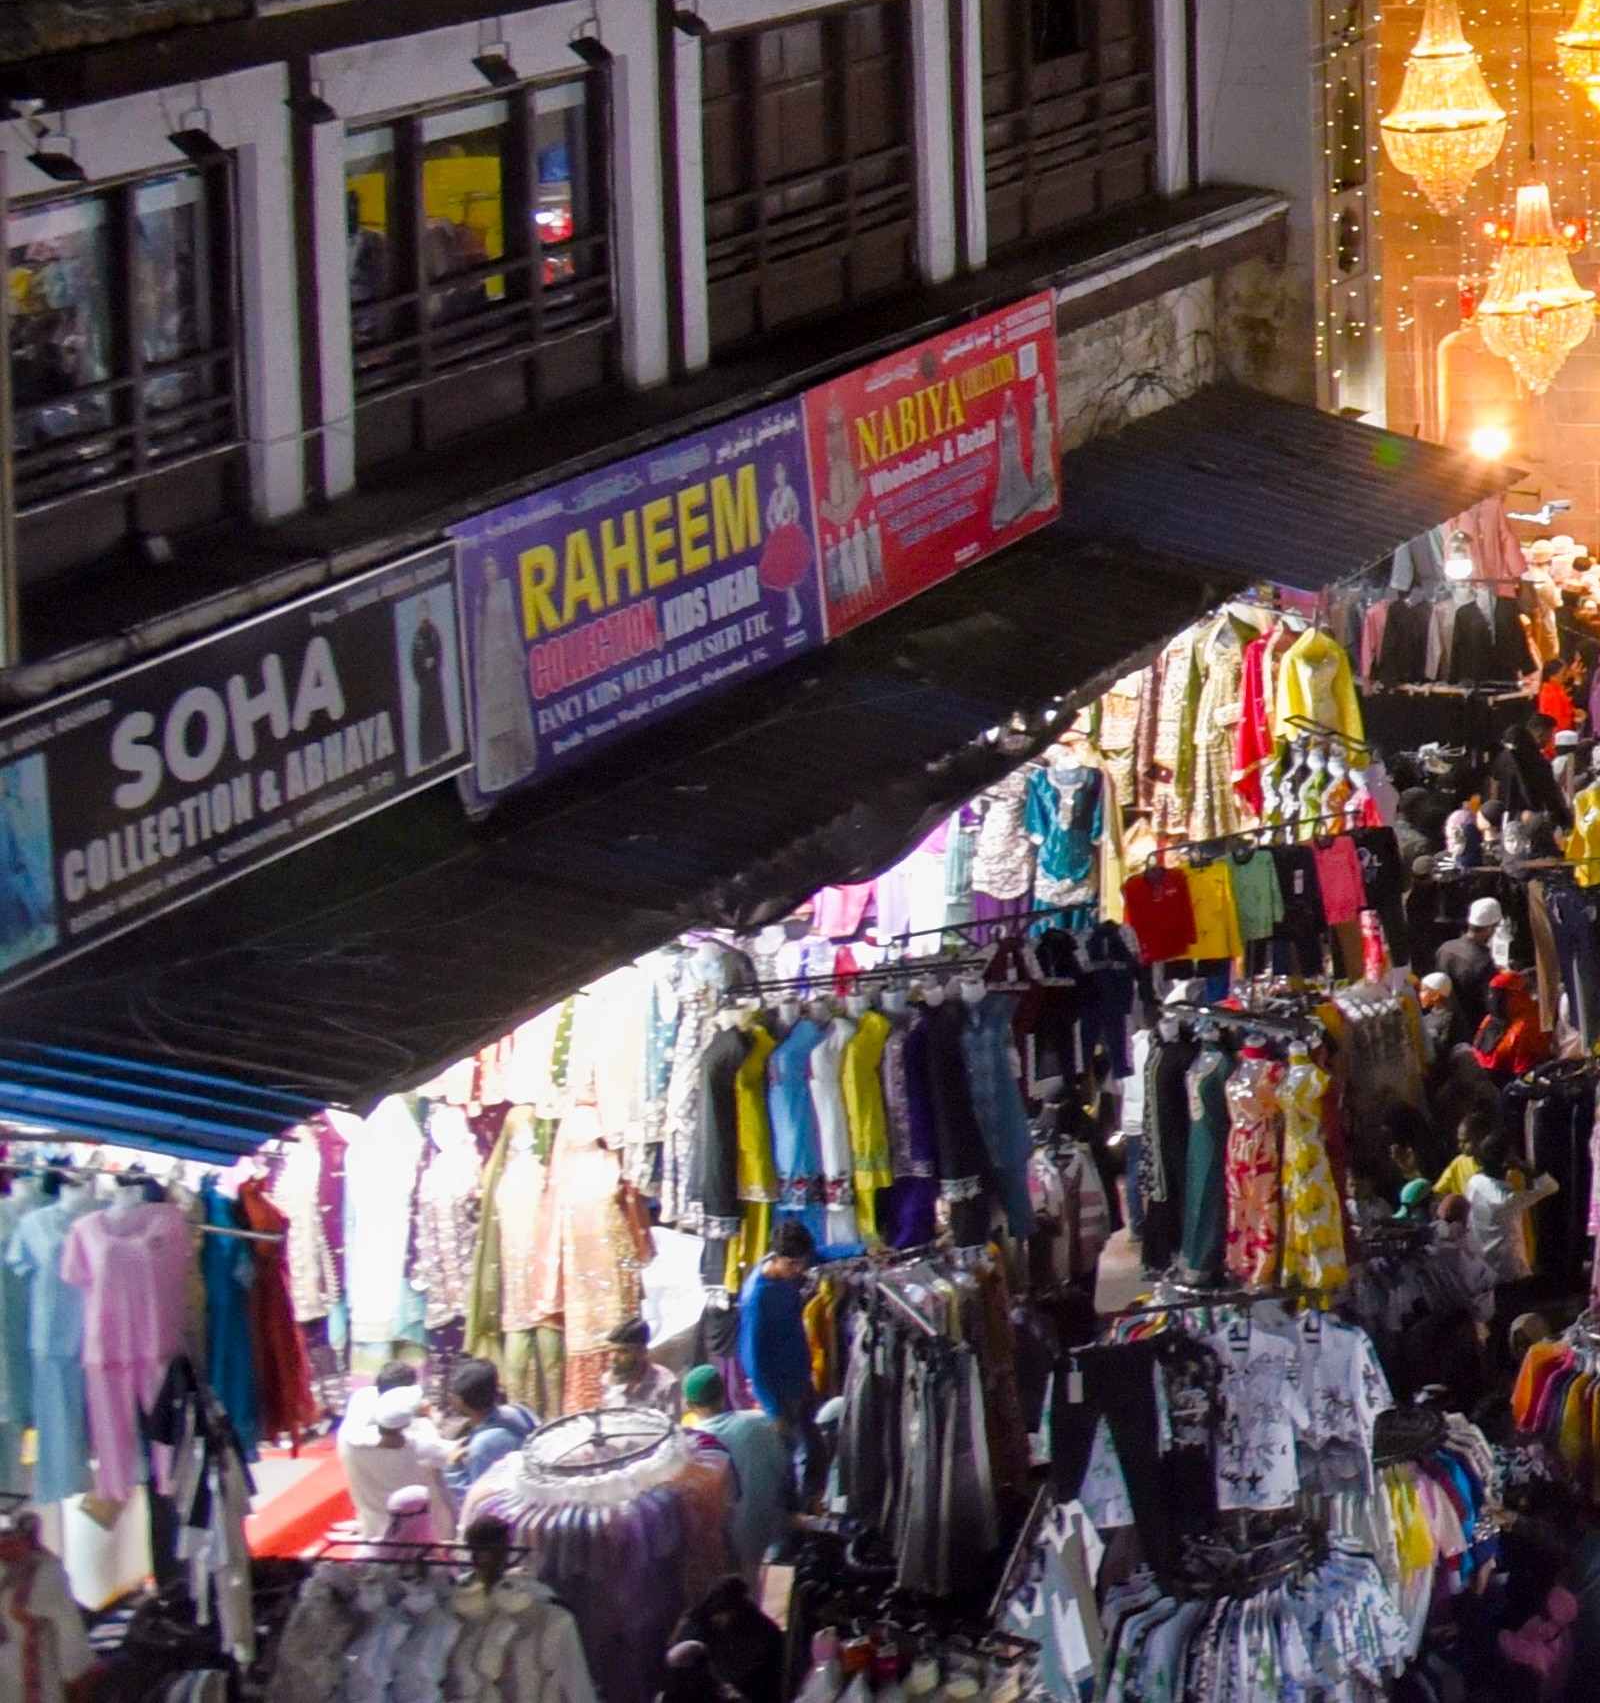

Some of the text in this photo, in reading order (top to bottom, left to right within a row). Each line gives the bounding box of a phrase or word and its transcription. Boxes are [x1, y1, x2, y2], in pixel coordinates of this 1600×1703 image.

[855, 375, 966, 471] NABIYA
[868, 449, 941, 498] Wholesale
[943, 439, 954, 465] &
[956, 418, 997, 453] Retail
[517, 463, 762, 640] RAHEEM
[706, 564, 761, 621] WEAR
[110, 636, 346, 810] SOHA
[62, 772, 255, 903] COLLECTION
[259, 769, 281, 813] &
